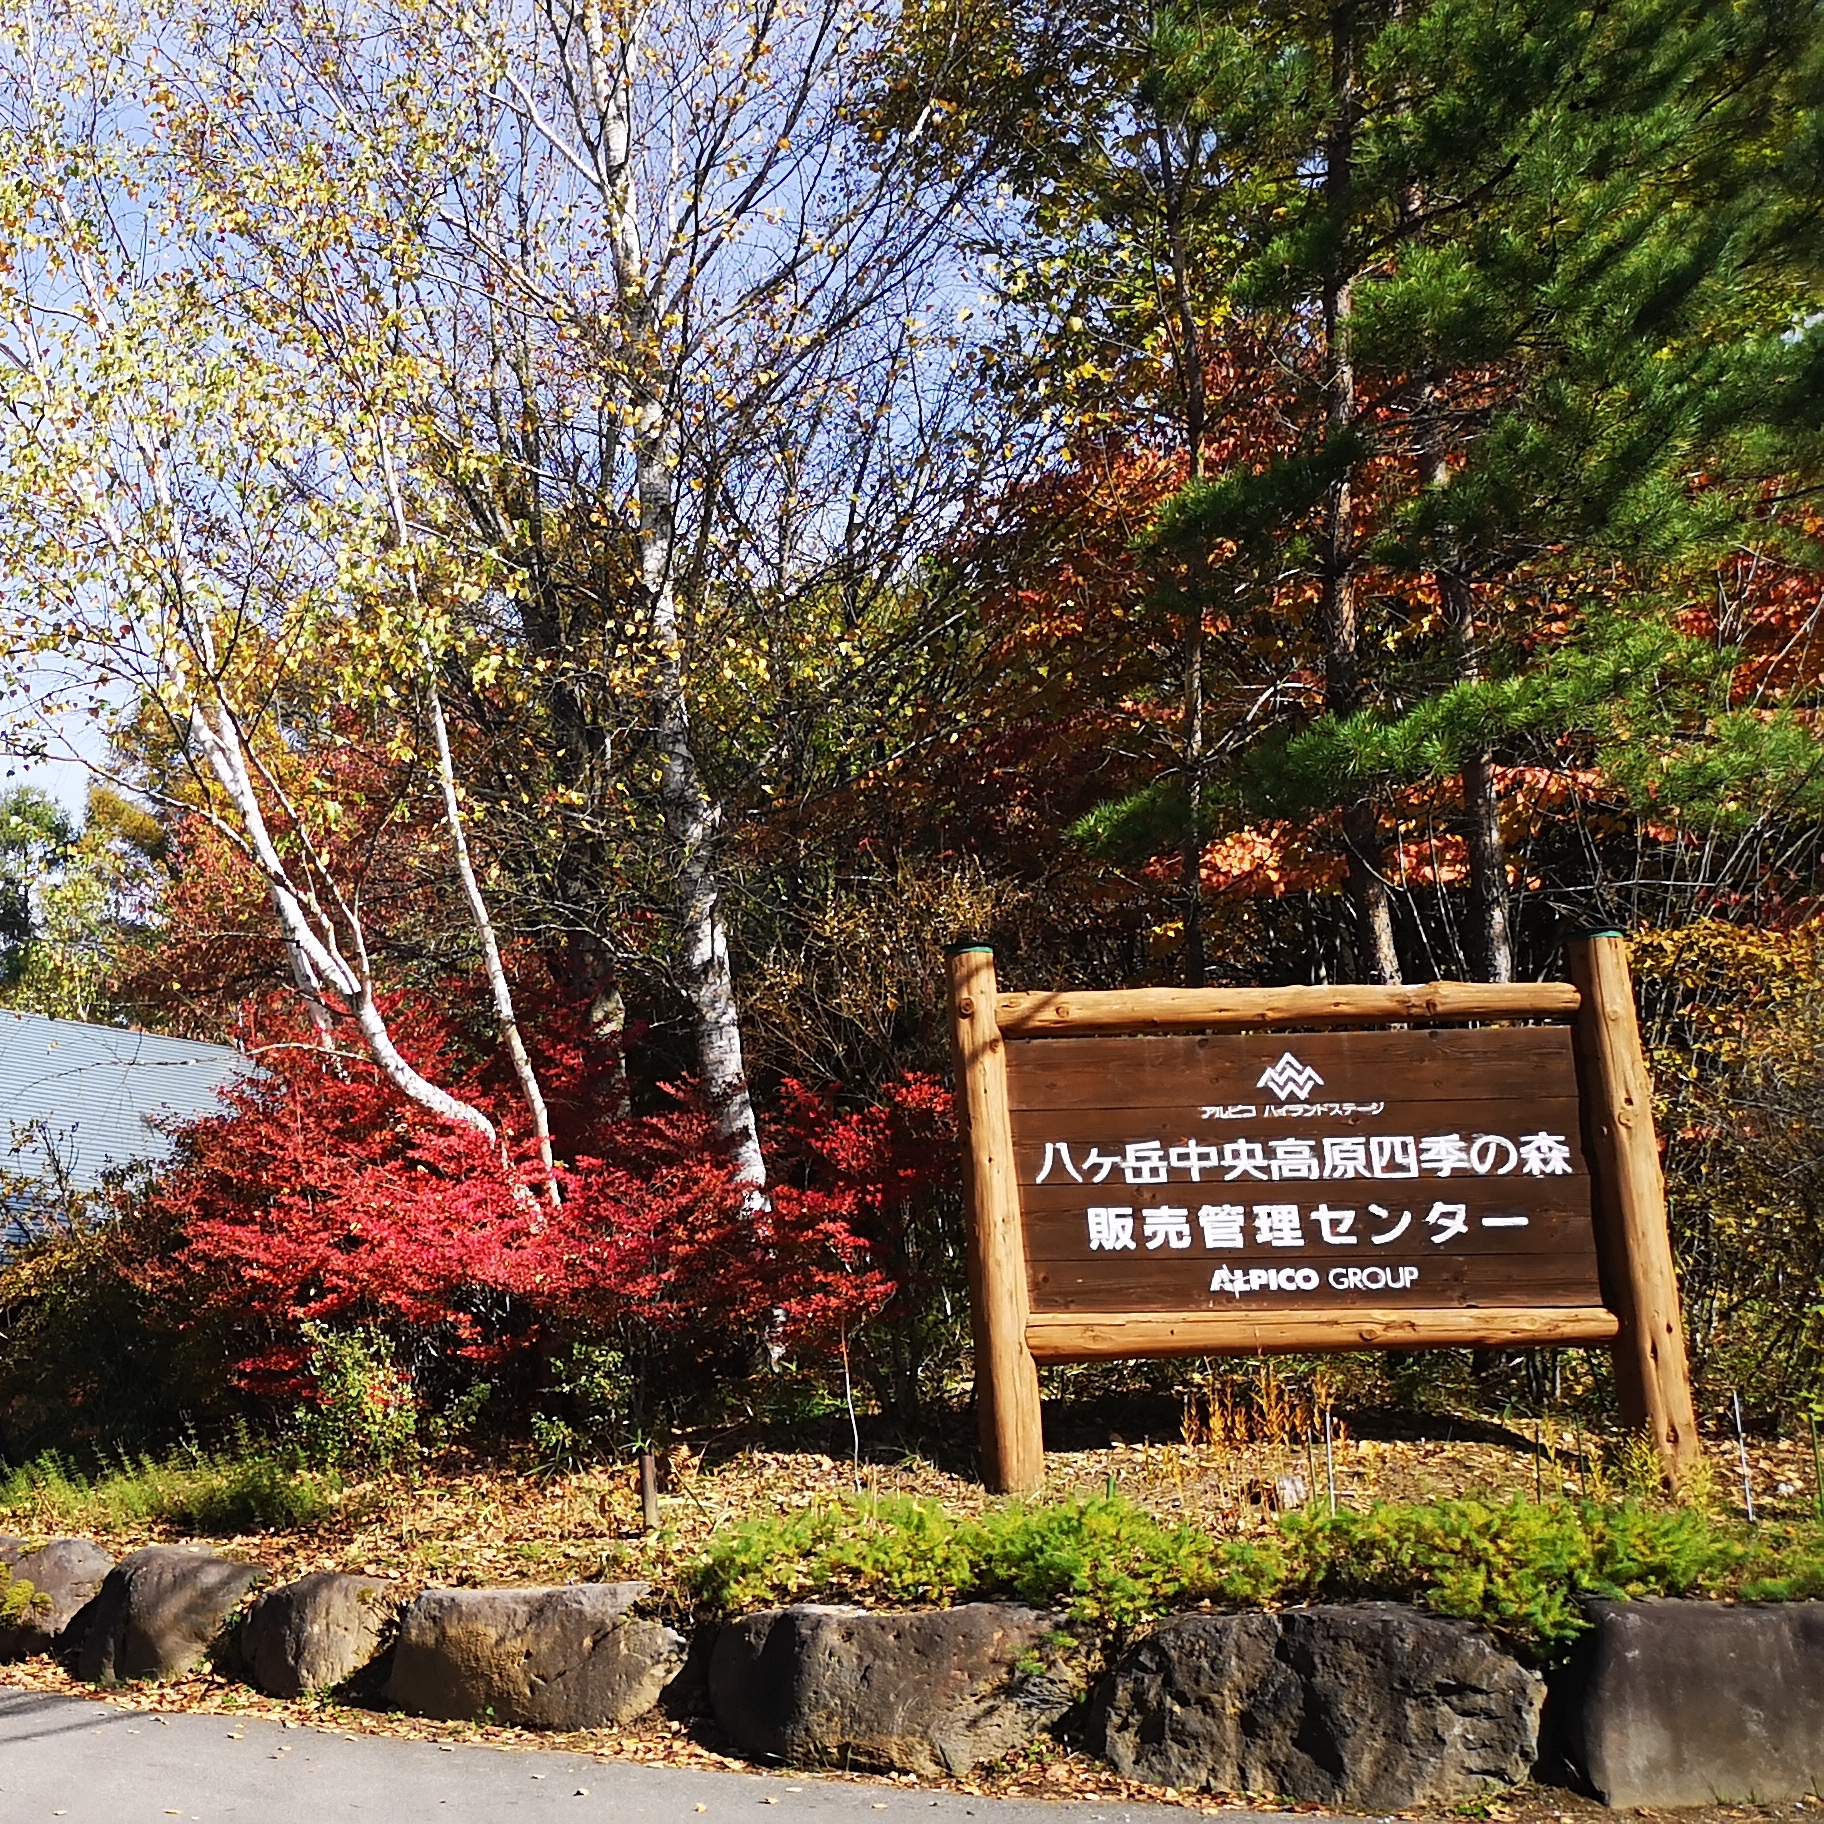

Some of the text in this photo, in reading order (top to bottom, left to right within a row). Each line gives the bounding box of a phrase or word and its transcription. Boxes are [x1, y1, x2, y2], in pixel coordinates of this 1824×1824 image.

[1200, 1101, 1385, 1120] アルピコ ハイランドステージ
[1086, 1201, 1529, 1251] 販売管理センター
[1209, 1263, 1419, 1299] ALPICO GROUP
